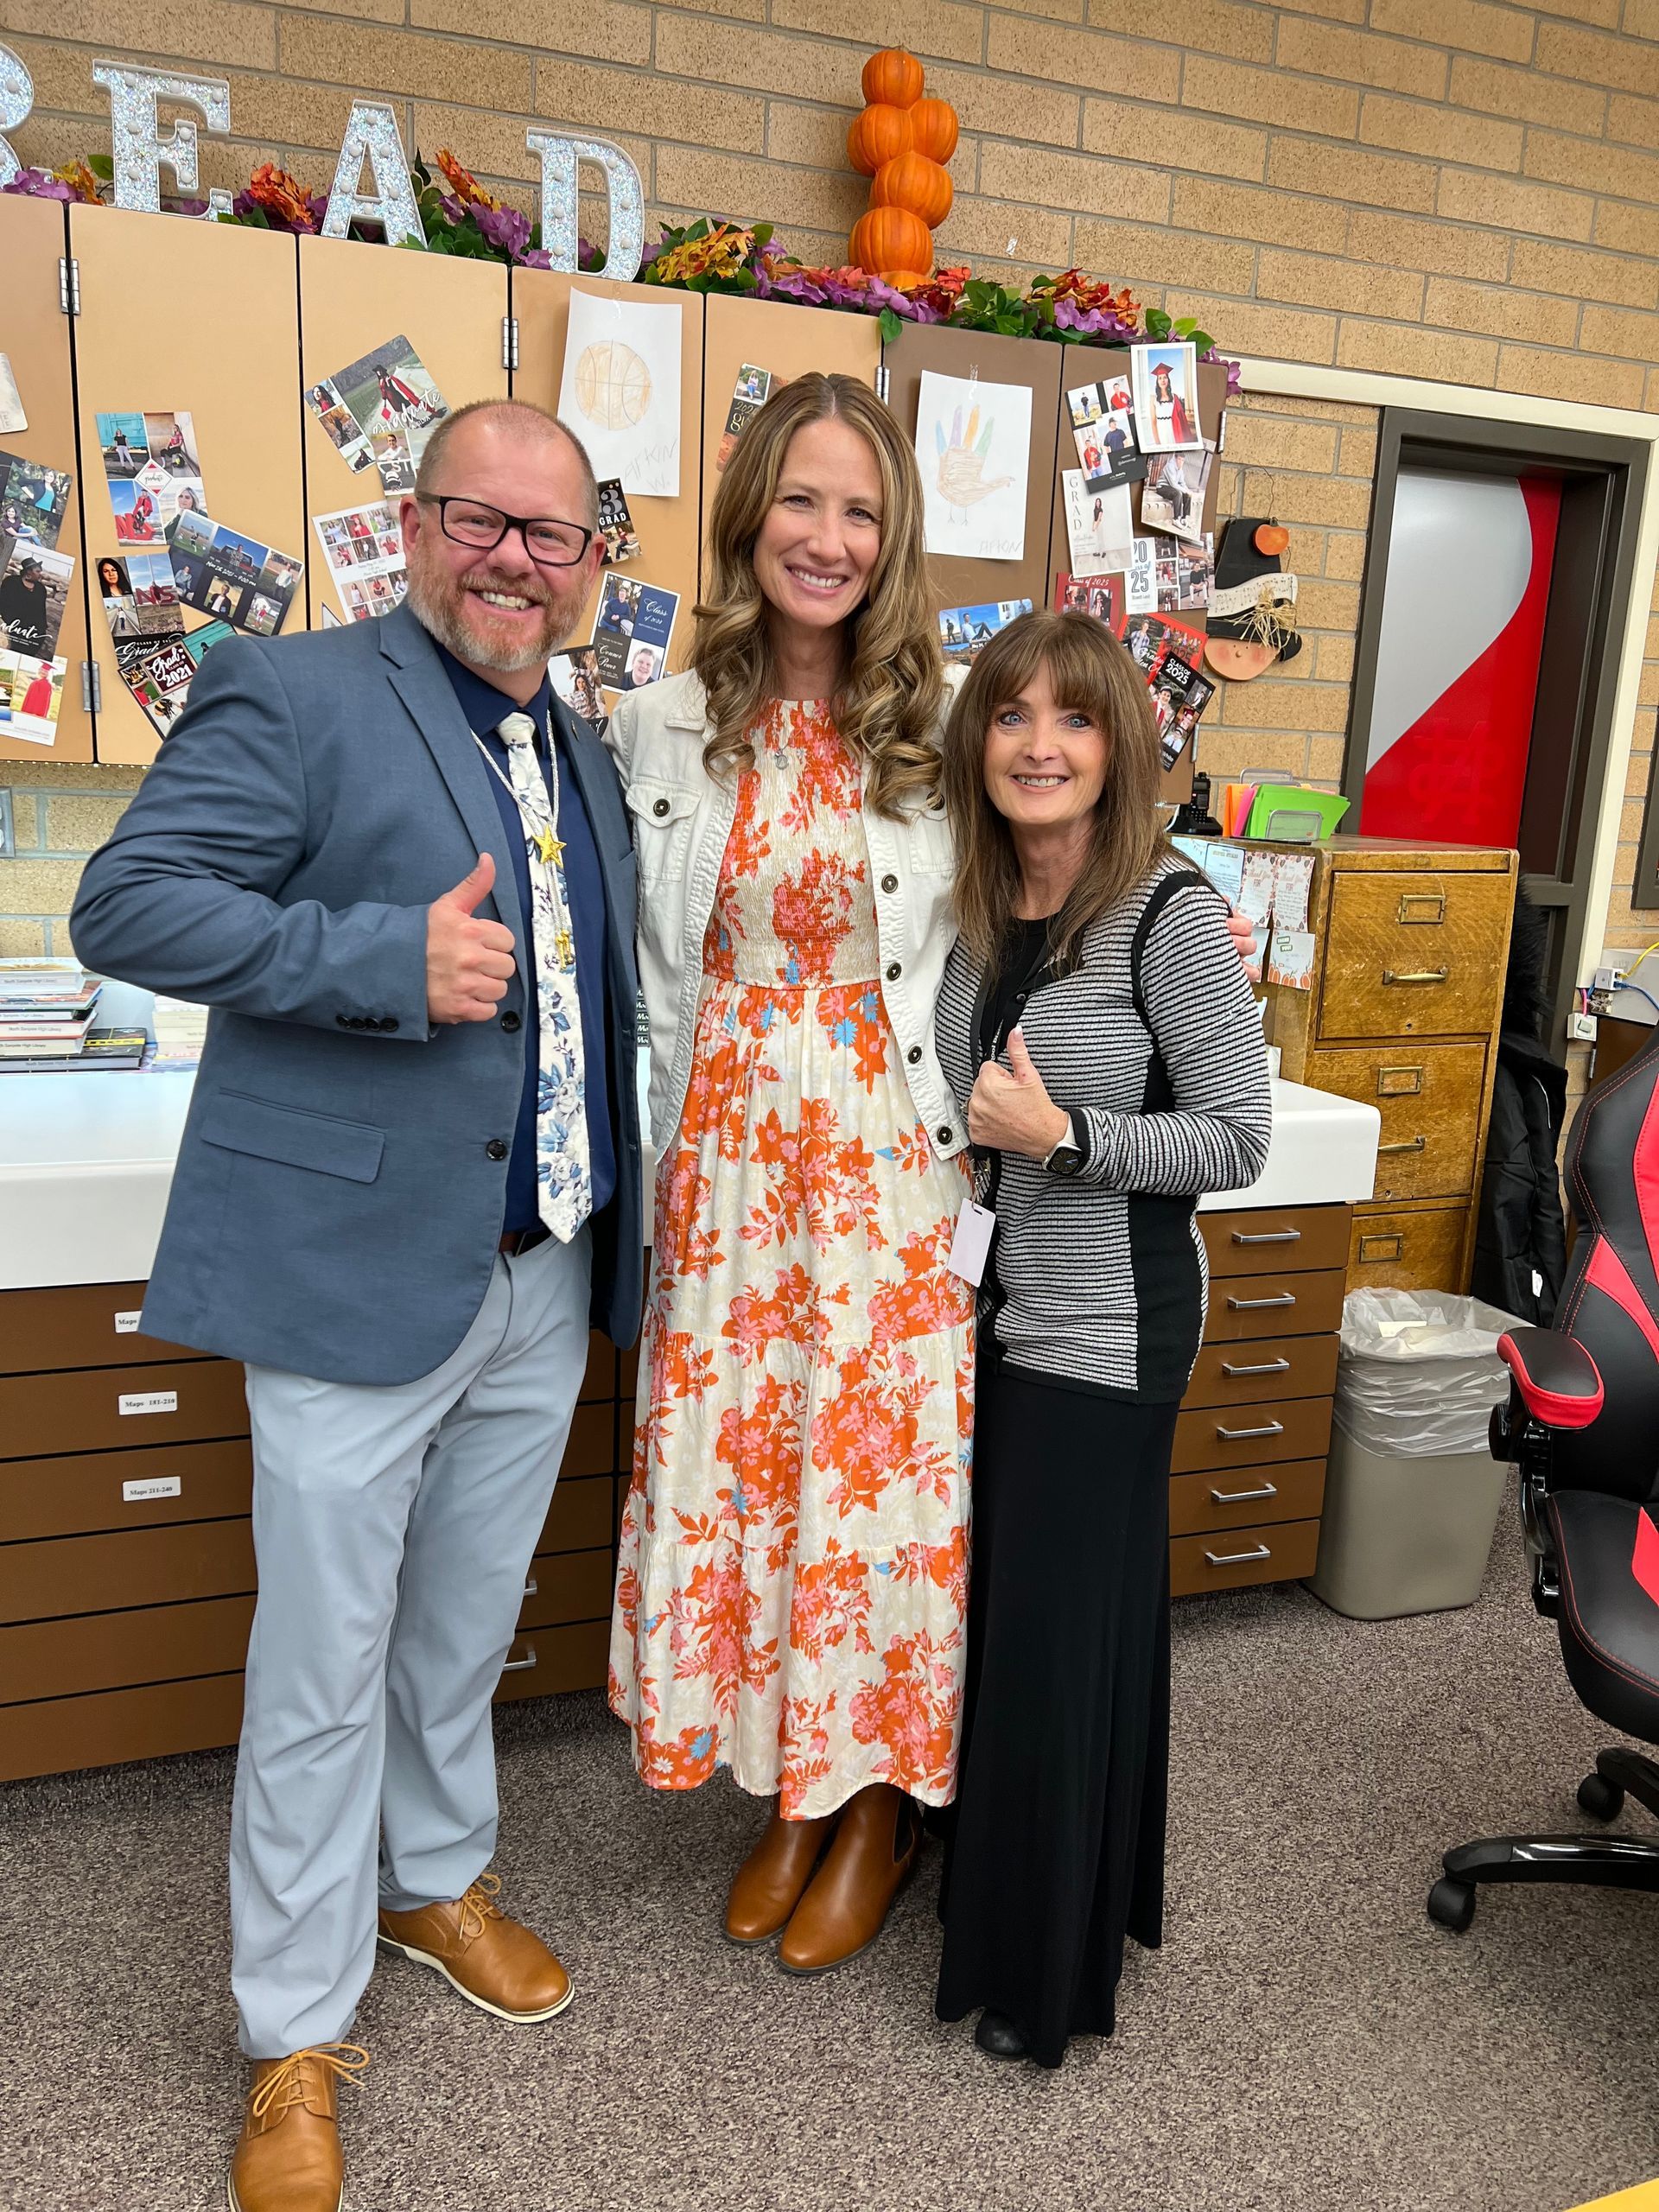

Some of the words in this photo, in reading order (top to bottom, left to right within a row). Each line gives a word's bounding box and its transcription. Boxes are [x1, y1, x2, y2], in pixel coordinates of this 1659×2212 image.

[0, 41, 646, 283] EAD
[734, 401, 757, 415] 202
[598, 489, 623, 515] 3
[599, 512, 627, 526] GRAD
[1091, 577, 1110, 587] 2025
[1130, 570, 1149, 594] 25
[0, 614, 54, 639] aduate
[164, 664, 194, 688] 2021
[1165, 663, 1190, 685] 2025
[1169, 658, 1185, 672] CLASS
[148, 1485, 173, 1494] 211-240
